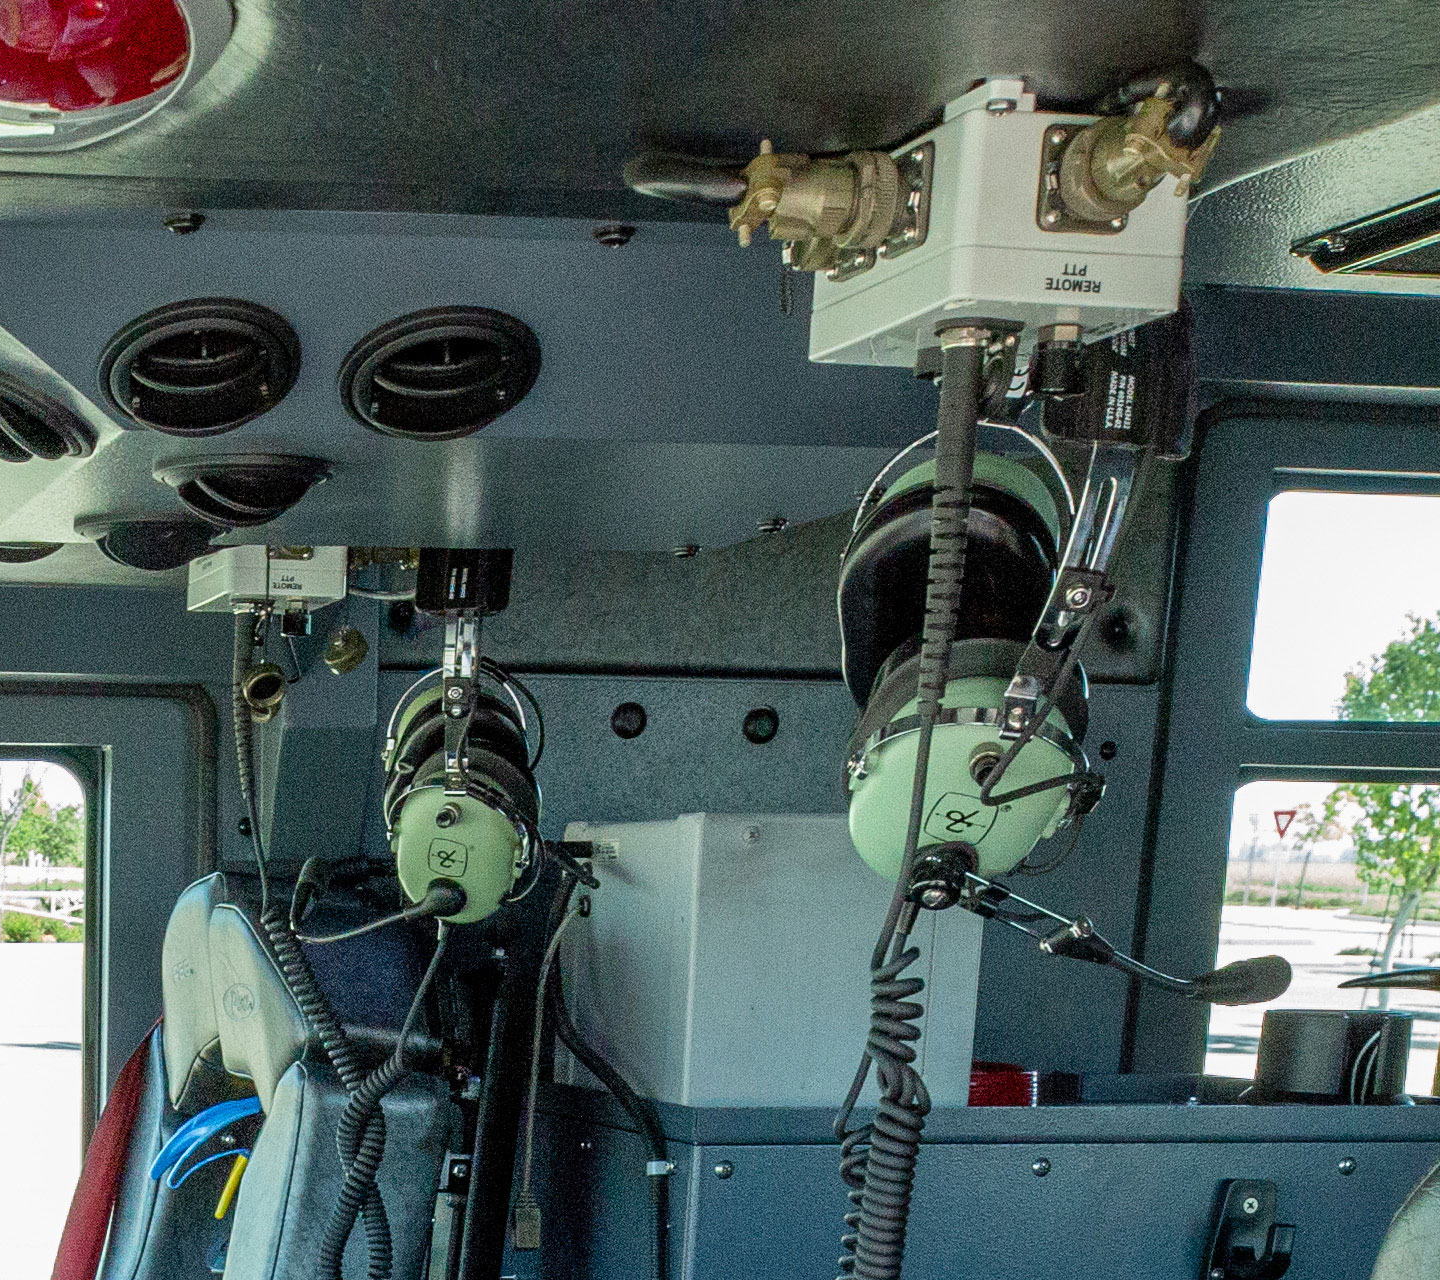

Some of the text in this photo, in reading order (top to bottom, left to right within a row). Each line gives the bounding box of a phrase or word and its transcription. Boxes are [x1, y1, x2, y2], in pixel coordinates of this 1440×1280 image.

[1062, 263, 1087, 276] PTT
[1045, 278, 1101, 293] REMOTE
[273, 580, 302, 590] REMOTE
